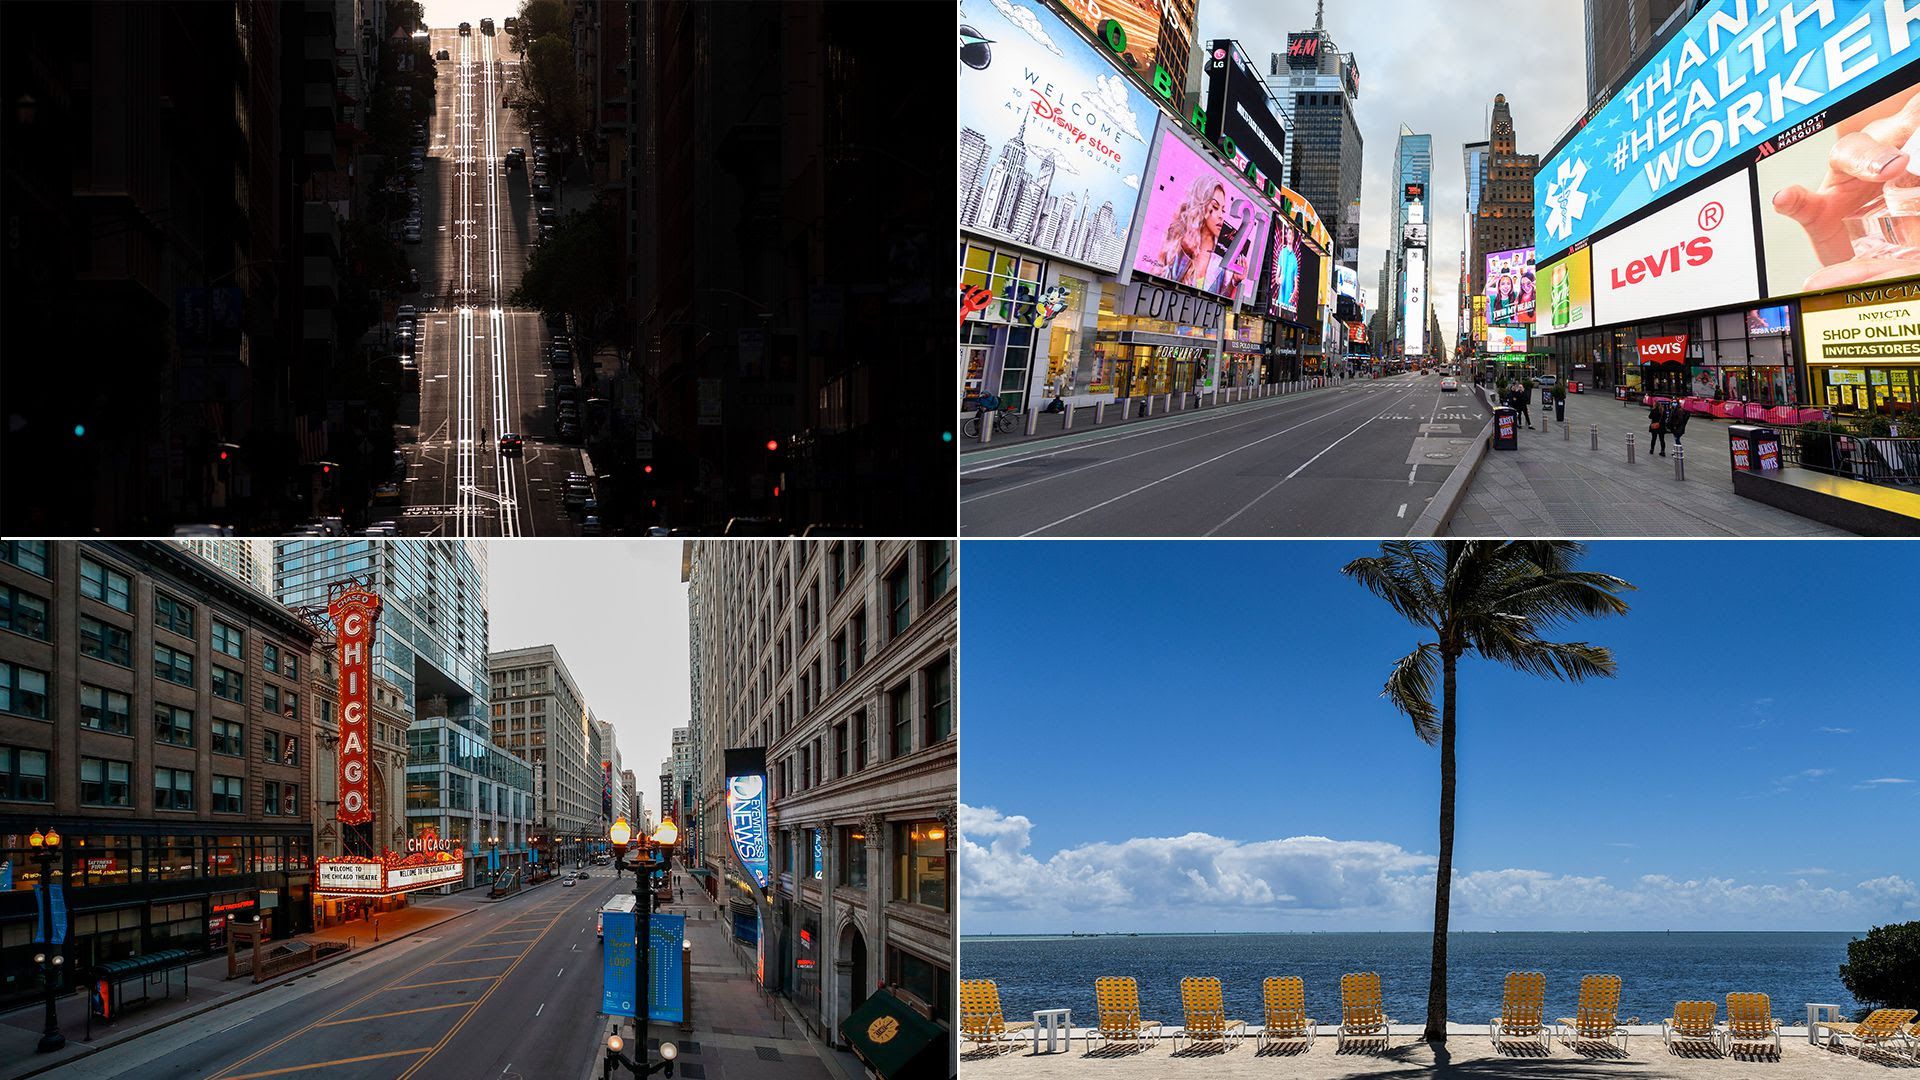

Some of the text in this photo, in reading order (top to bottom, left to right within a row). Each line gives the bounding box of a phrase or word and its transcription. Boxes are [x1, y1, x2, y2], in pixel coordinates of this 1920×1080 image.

[1289, 38, 1318, 57] H&M
[1213, 61, 1225, 69] LG
[1625, 0, 1769, 121] THAN
[1012, 87, 1022, 98] TO
[1614, 0, 1835, 174] #HEALTH
[1025, 67, 1121, 144] WELCOME
[1030, 88, 1122, 163] Disney store
[1778, 110, 1828, 142] MARRIOTT
[1005, 101, 1121, 174] AT TIMES SQUARE
[1778, 121, 1824, 149] MARQUIS
[1230, 198, 1271, 282] 21
[1845, 284, 1920, 305] INVICTA
[1134, 283, 1223, 329] FOREVER
[1508, 306, 1516, 316] MY
[1517, 300, 1535, 312] HEART
[1858, 308, 1911, 321] INVICTA
[1823, 328, 1861, 341] SHOP
[1156, 345, 1195, 359] FOREVER
[1825, 343, 1920, 356] INVICTASTORES
[1731, 439, 1750, 451] JERSEY
[1758, 440, 1778, 456] JERSEY
[1734, 454, 1750, 467] BOYS
[1761, 456, 1778, 470] BOYS
[337, 594, 361, 609] CHASE
[343, 613, 363, 813] CHICAGO
[733, 800, 756, 858] NEWS
[751, 799, 764, 858] EYEWITNESS
[408, 838, 450, 851] CHICAGO
[400, 869, 416, 877] WELCOME
[610, 957, 631, 967] LOOP
